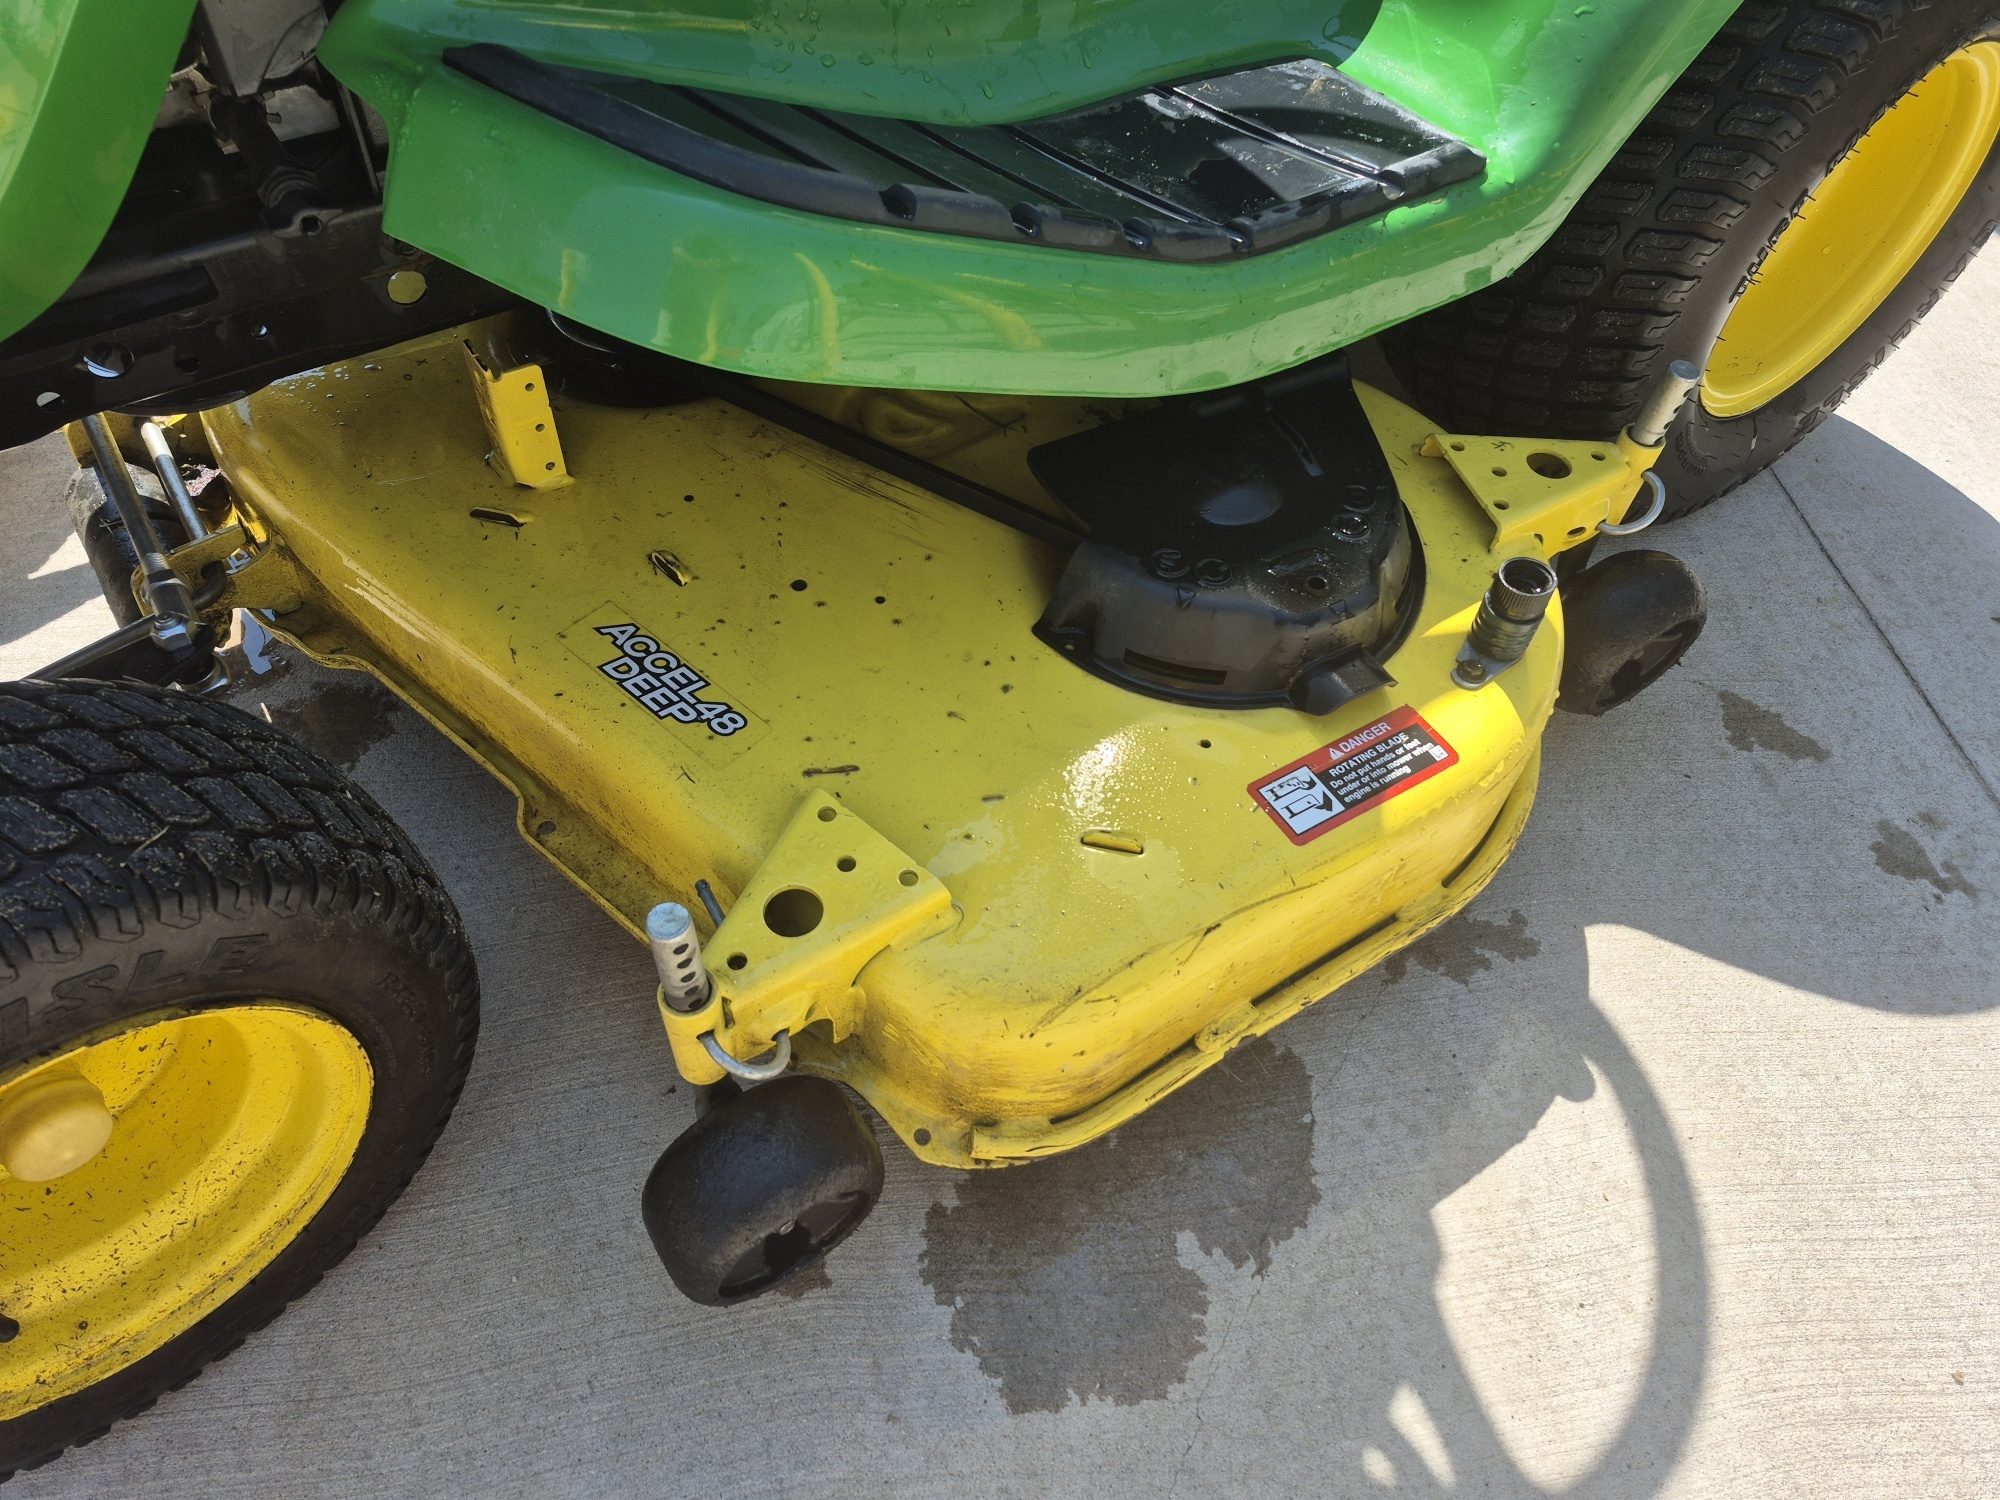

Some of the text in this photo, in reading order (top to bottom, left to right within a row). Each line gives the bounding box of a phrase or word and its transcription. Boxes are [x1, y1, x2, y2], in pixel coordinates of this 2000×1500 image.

[593, 622, 748, 737] ACCEL 48
[597, 655, 700, 724] DEEP
[1328, 732, 1409, 777] ROTATING BLADE
[1338, 722, 1392, 753] DANGER
[1329, 738, 1421, 789] Do not put hands or feet
[1337, 742, 1435, 796] under or into mower when
[1344, 764, 1412, 804] engine is running
